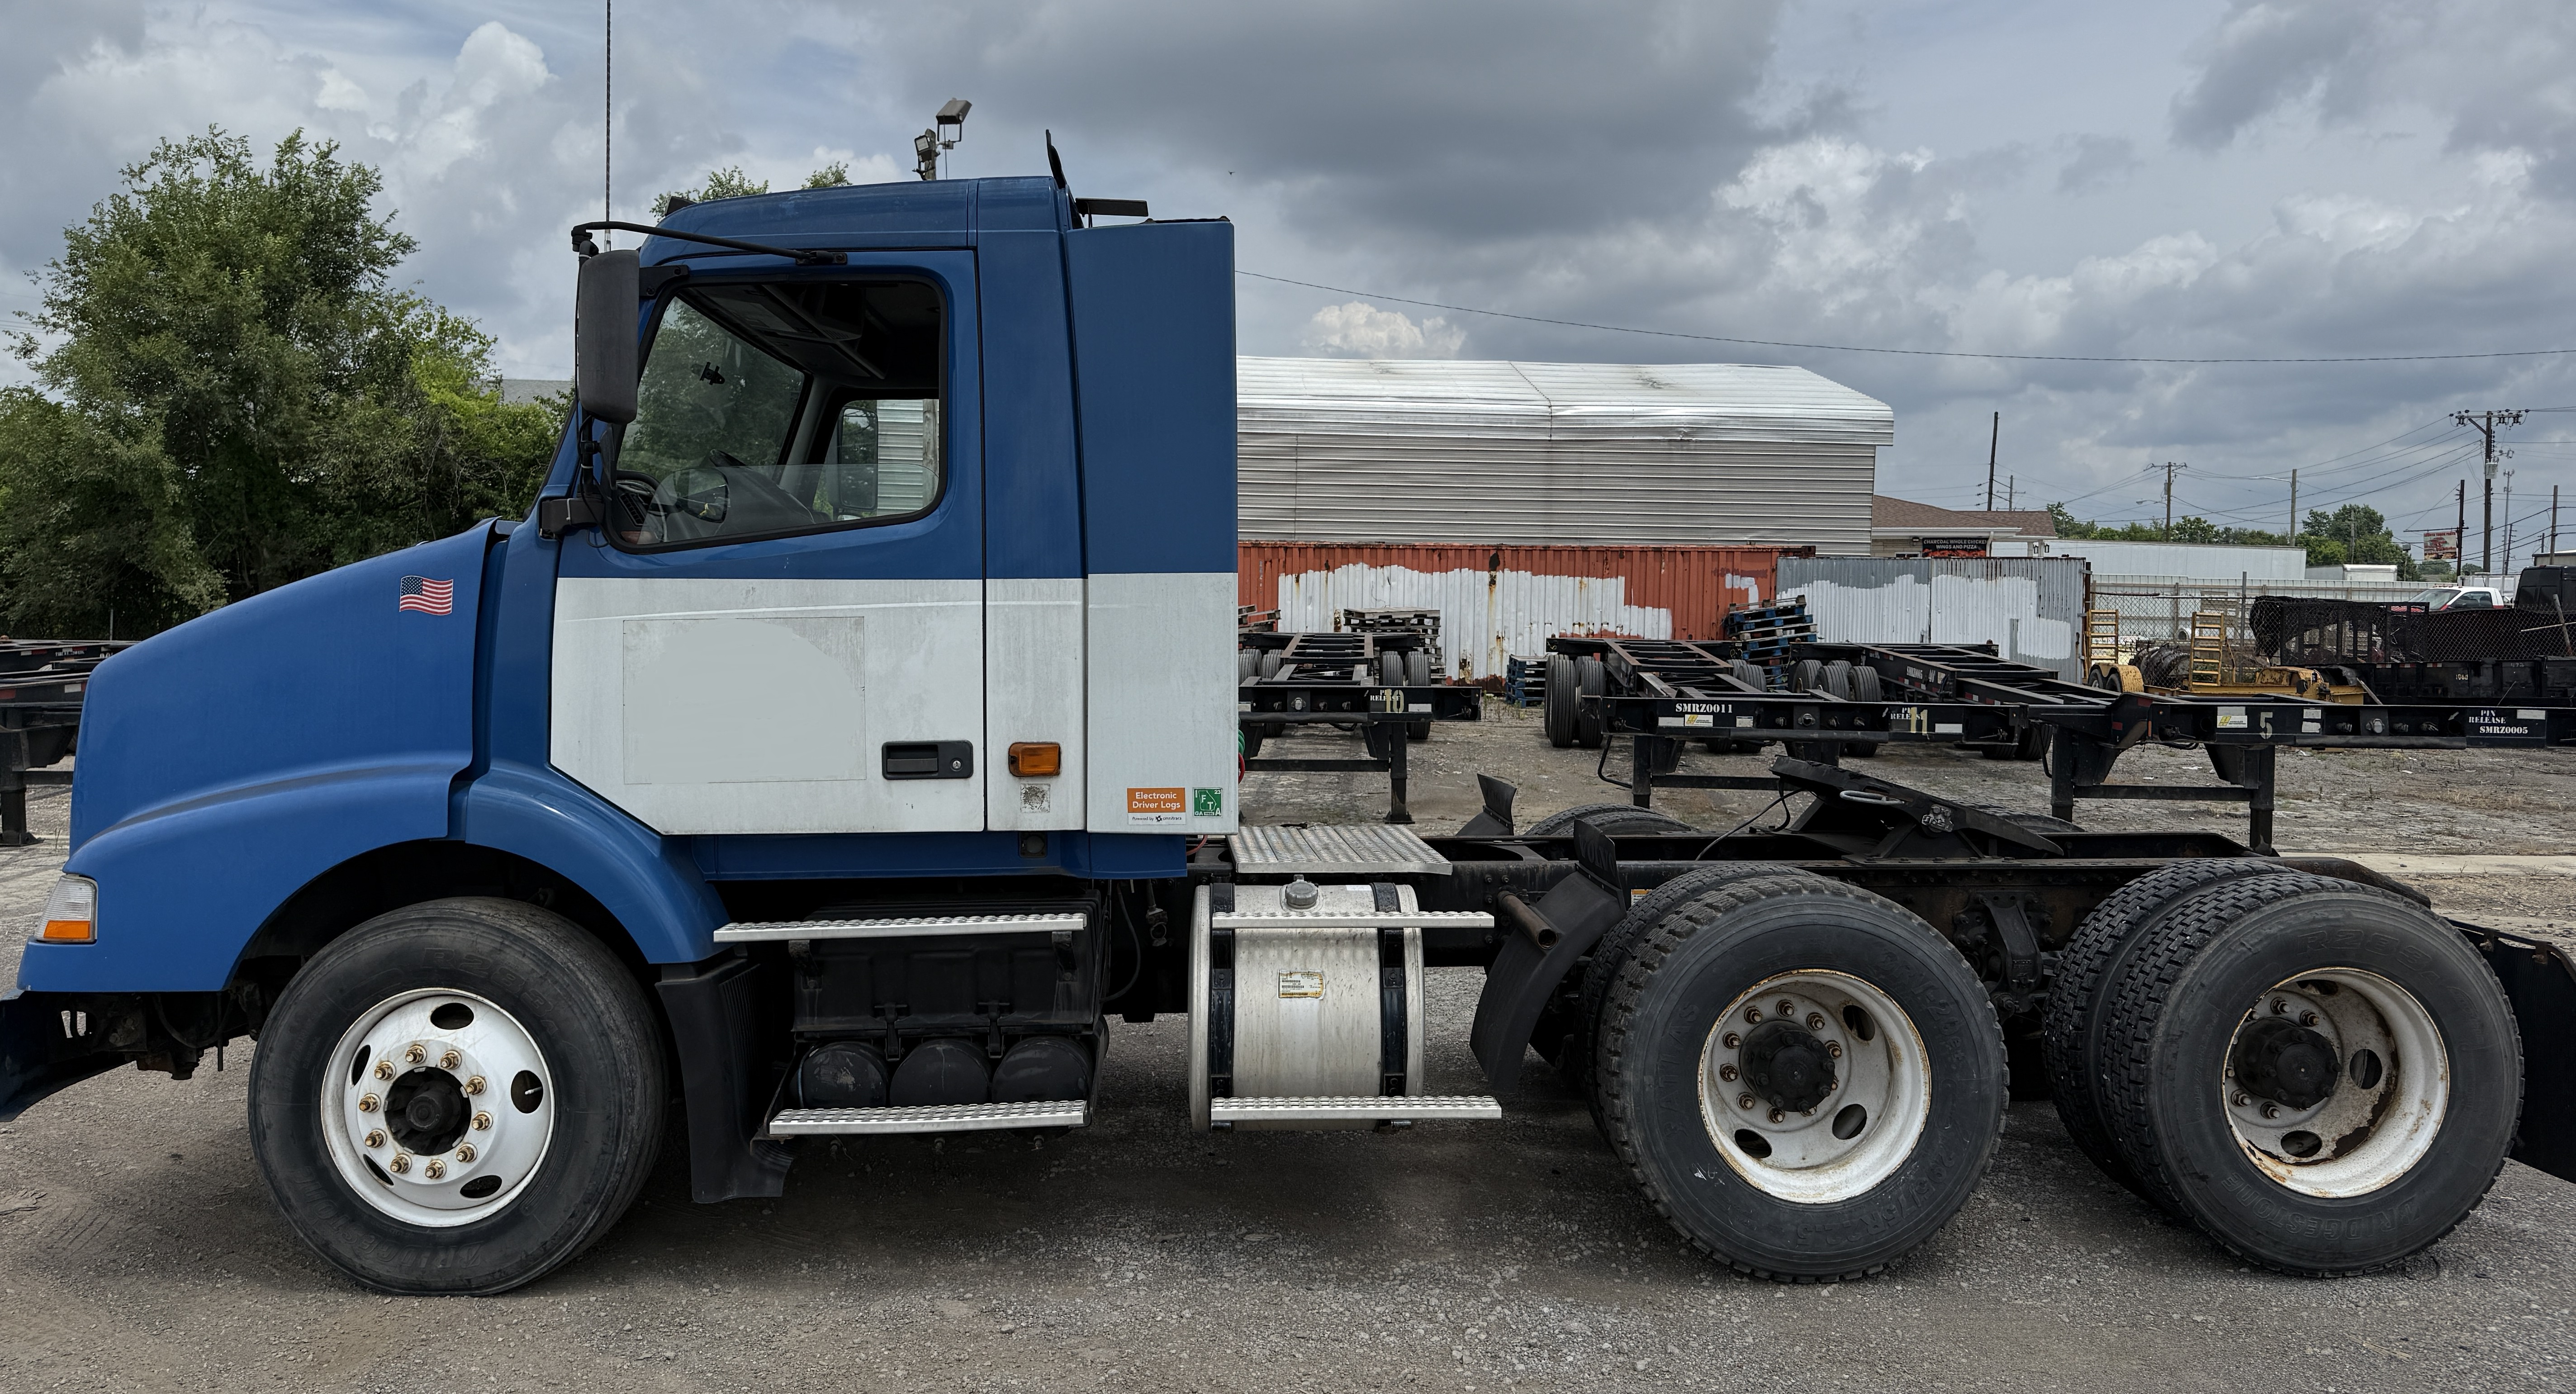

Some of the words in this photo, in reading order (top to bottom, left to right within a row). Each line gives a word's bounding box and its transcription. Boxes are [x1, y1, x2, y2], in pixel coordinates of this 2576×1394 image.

[1385, 689, 1404, 714] 10
[1675, 703, 1732, 713] SMRZ0011
[1911, 707, 1928, 735] 11
[2259, 712, 2273, 740] 5
[2480, 726, 2528, 734] SMRZ0005
[1161, 801, 1181, 810] Logs
[2221, 1173, 2421, 1241] BRIDGESTONE
